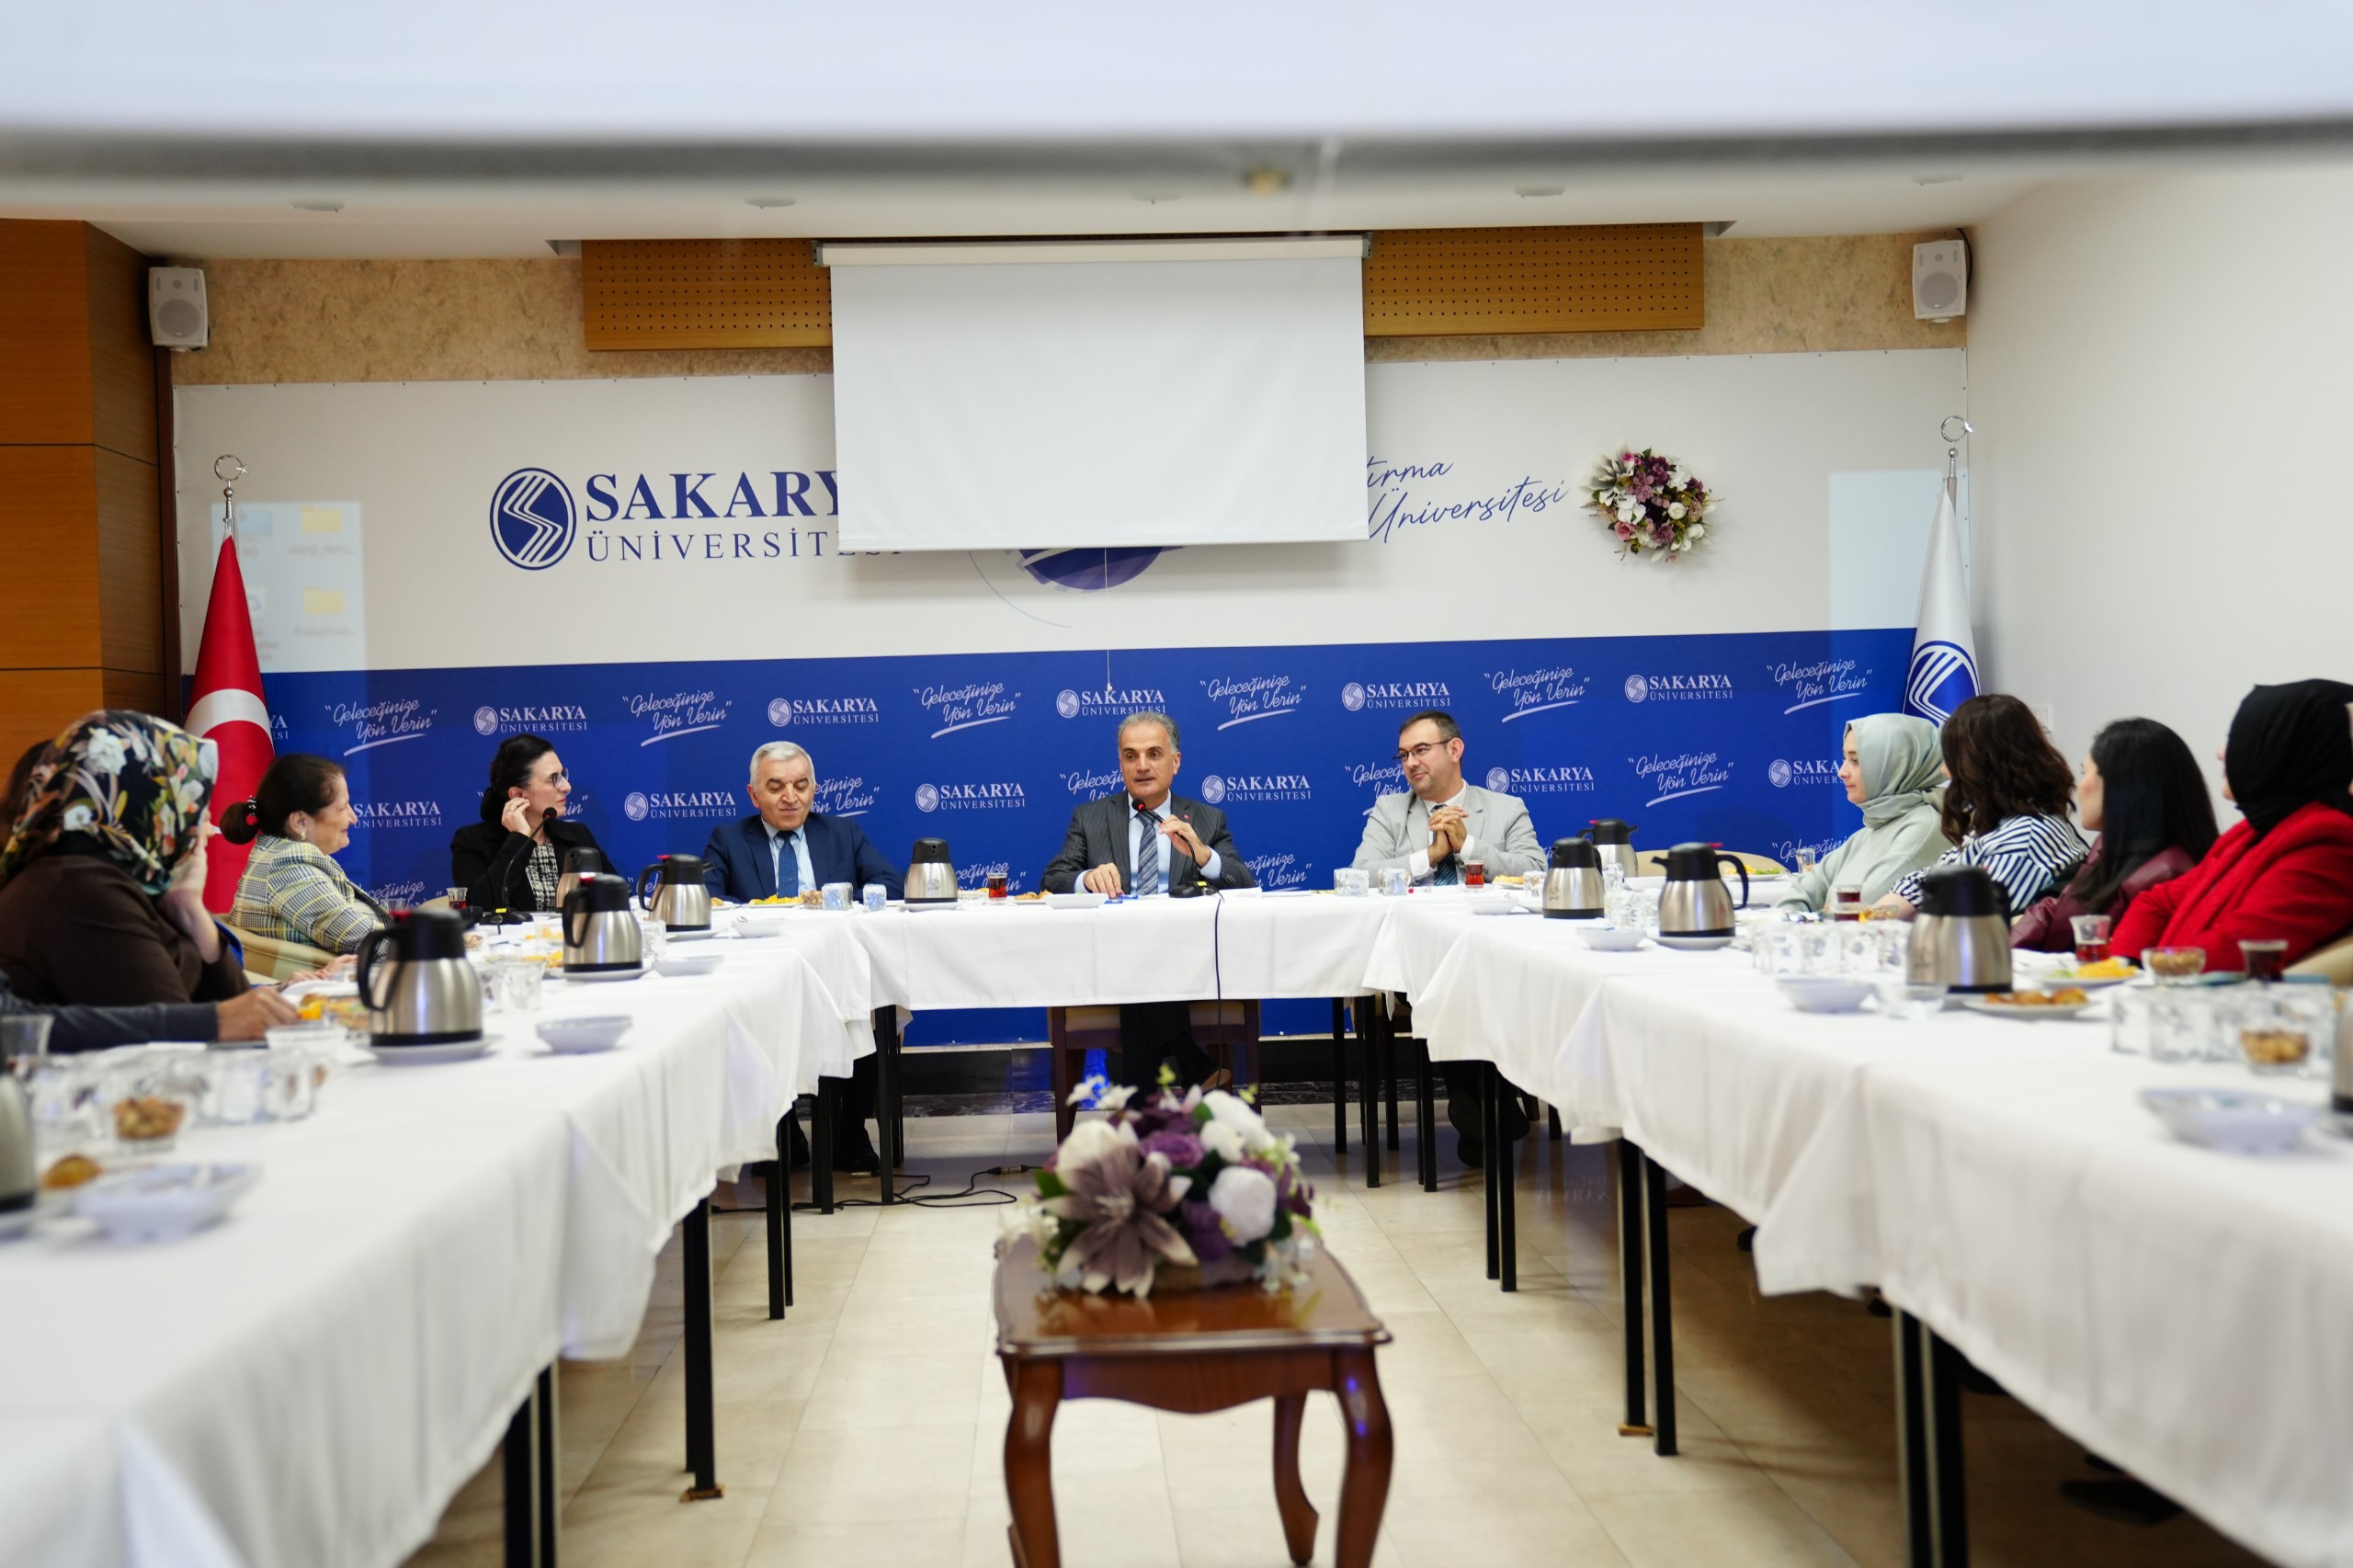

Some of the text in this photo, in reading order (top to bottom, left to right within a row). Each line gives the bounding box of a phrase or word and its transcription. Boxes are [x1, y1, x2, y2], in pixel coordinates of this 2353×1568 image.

[585, 471, 838, 522] SAKARY
[1369, 476, 1570, 543] Üniversitesi
[585, 528, 902, 562] ÜNİVERSİT
[1649, 675, 1733, 690] SAKARYA
[1081, 689, 1165, 705] SAKARYA
[1366, 683, 1450, 699] SAKARYA
[1513, 688, 1542, 710] Yön
[1649, 690, 1733, 701] ÜNİVERSİTESİ
[1796, 681, 1824, 703] Yön
[793, 698, 878, 714] SAKARYA
[1229, 696, 1258, 719] Yön
[1366, 698, 1450, 709] ÜNİVERSİTESİ
[500, 706, 586, 722] SAKARYA
[793, 713, 879, 724] ÜNİVERSİTESİ
[943, 704, 972, 727] Yön
[500, 719, 587, 733] ÜNİVERSİTESİ
[653, 712, 683, 734] Yön
[356, 721, 387, 744] Yön
[1511, 767, 1594, 782] SAKARYA
[1793, 760, 1841, 774] SAKA
[1227, 776, 1311, 790] SAKARYA
[1511, 781, 1594, 792] ÜNİVERSİTESİ
[1657, 773, 1686, 796] Yön
[940, 783, 1025, 800] SAKARYA
[1227, 790, 1311, 801] ÜNİVERSİTESİ
[650, 792, 735, 808] SAKARYA
[940, 799, 1026, 810] ÜNİVERSİTESİ
[353, 801, 441, 817] SAKARYA
[650, 807, 736, 818] ÜNİVERSİTESİ
